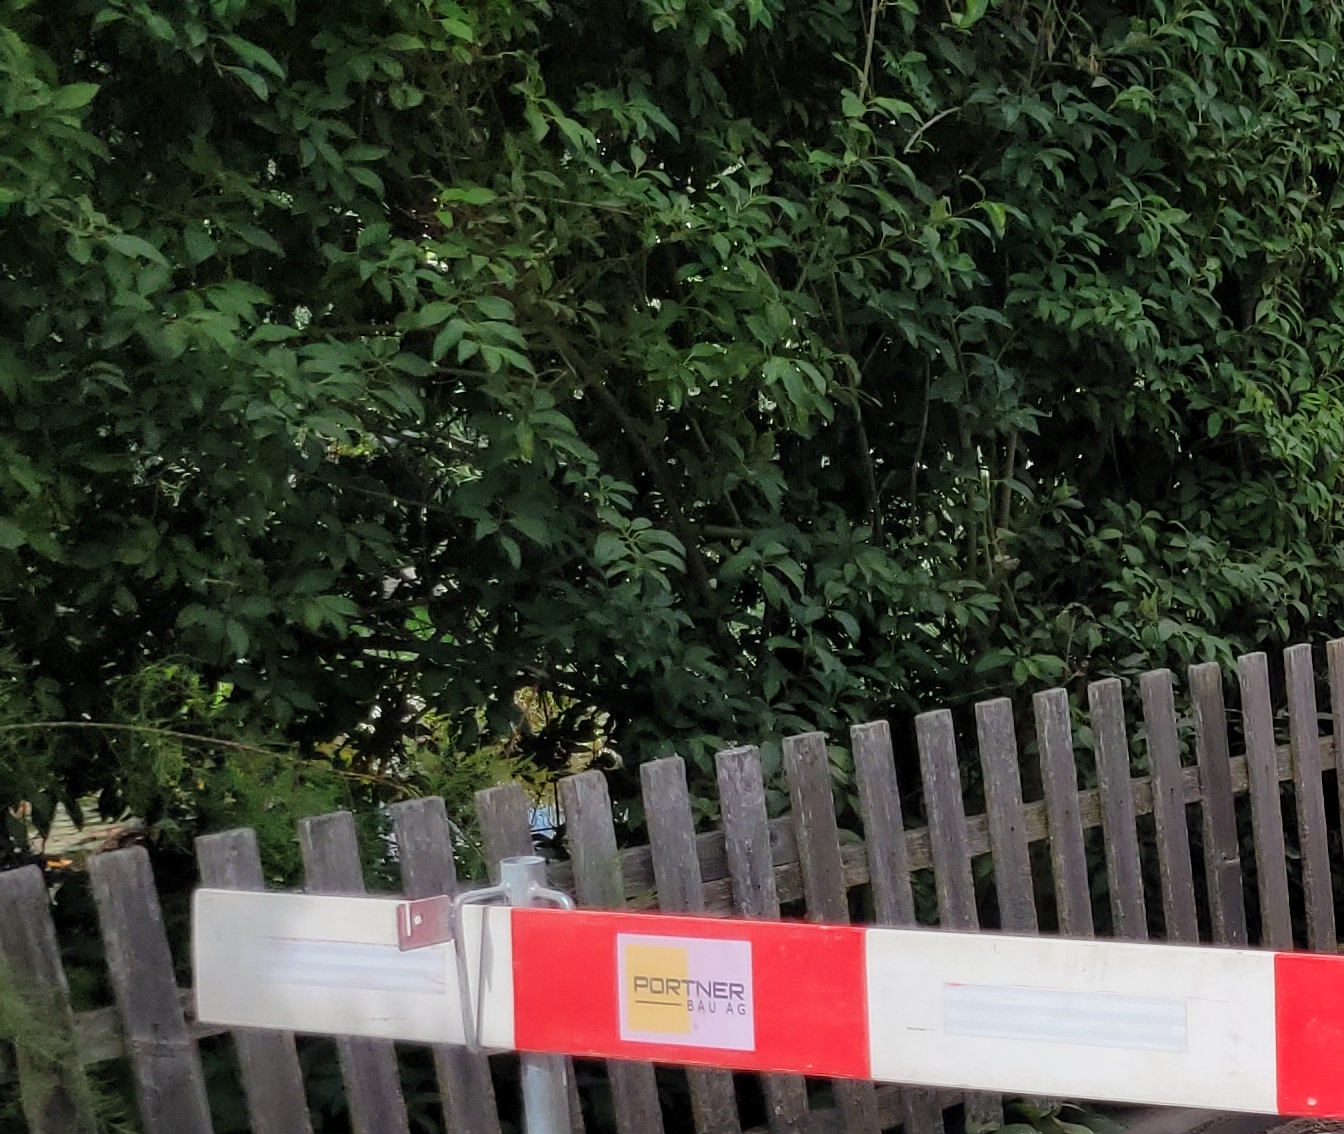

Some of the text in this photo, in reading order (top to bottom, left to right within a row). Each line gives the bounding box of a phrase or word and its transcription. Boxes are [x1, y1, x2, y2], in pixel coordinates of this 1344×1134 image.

[633, 975, 745, 1001] PORTNER
[687, 999, 747, 1016] BAU AG
